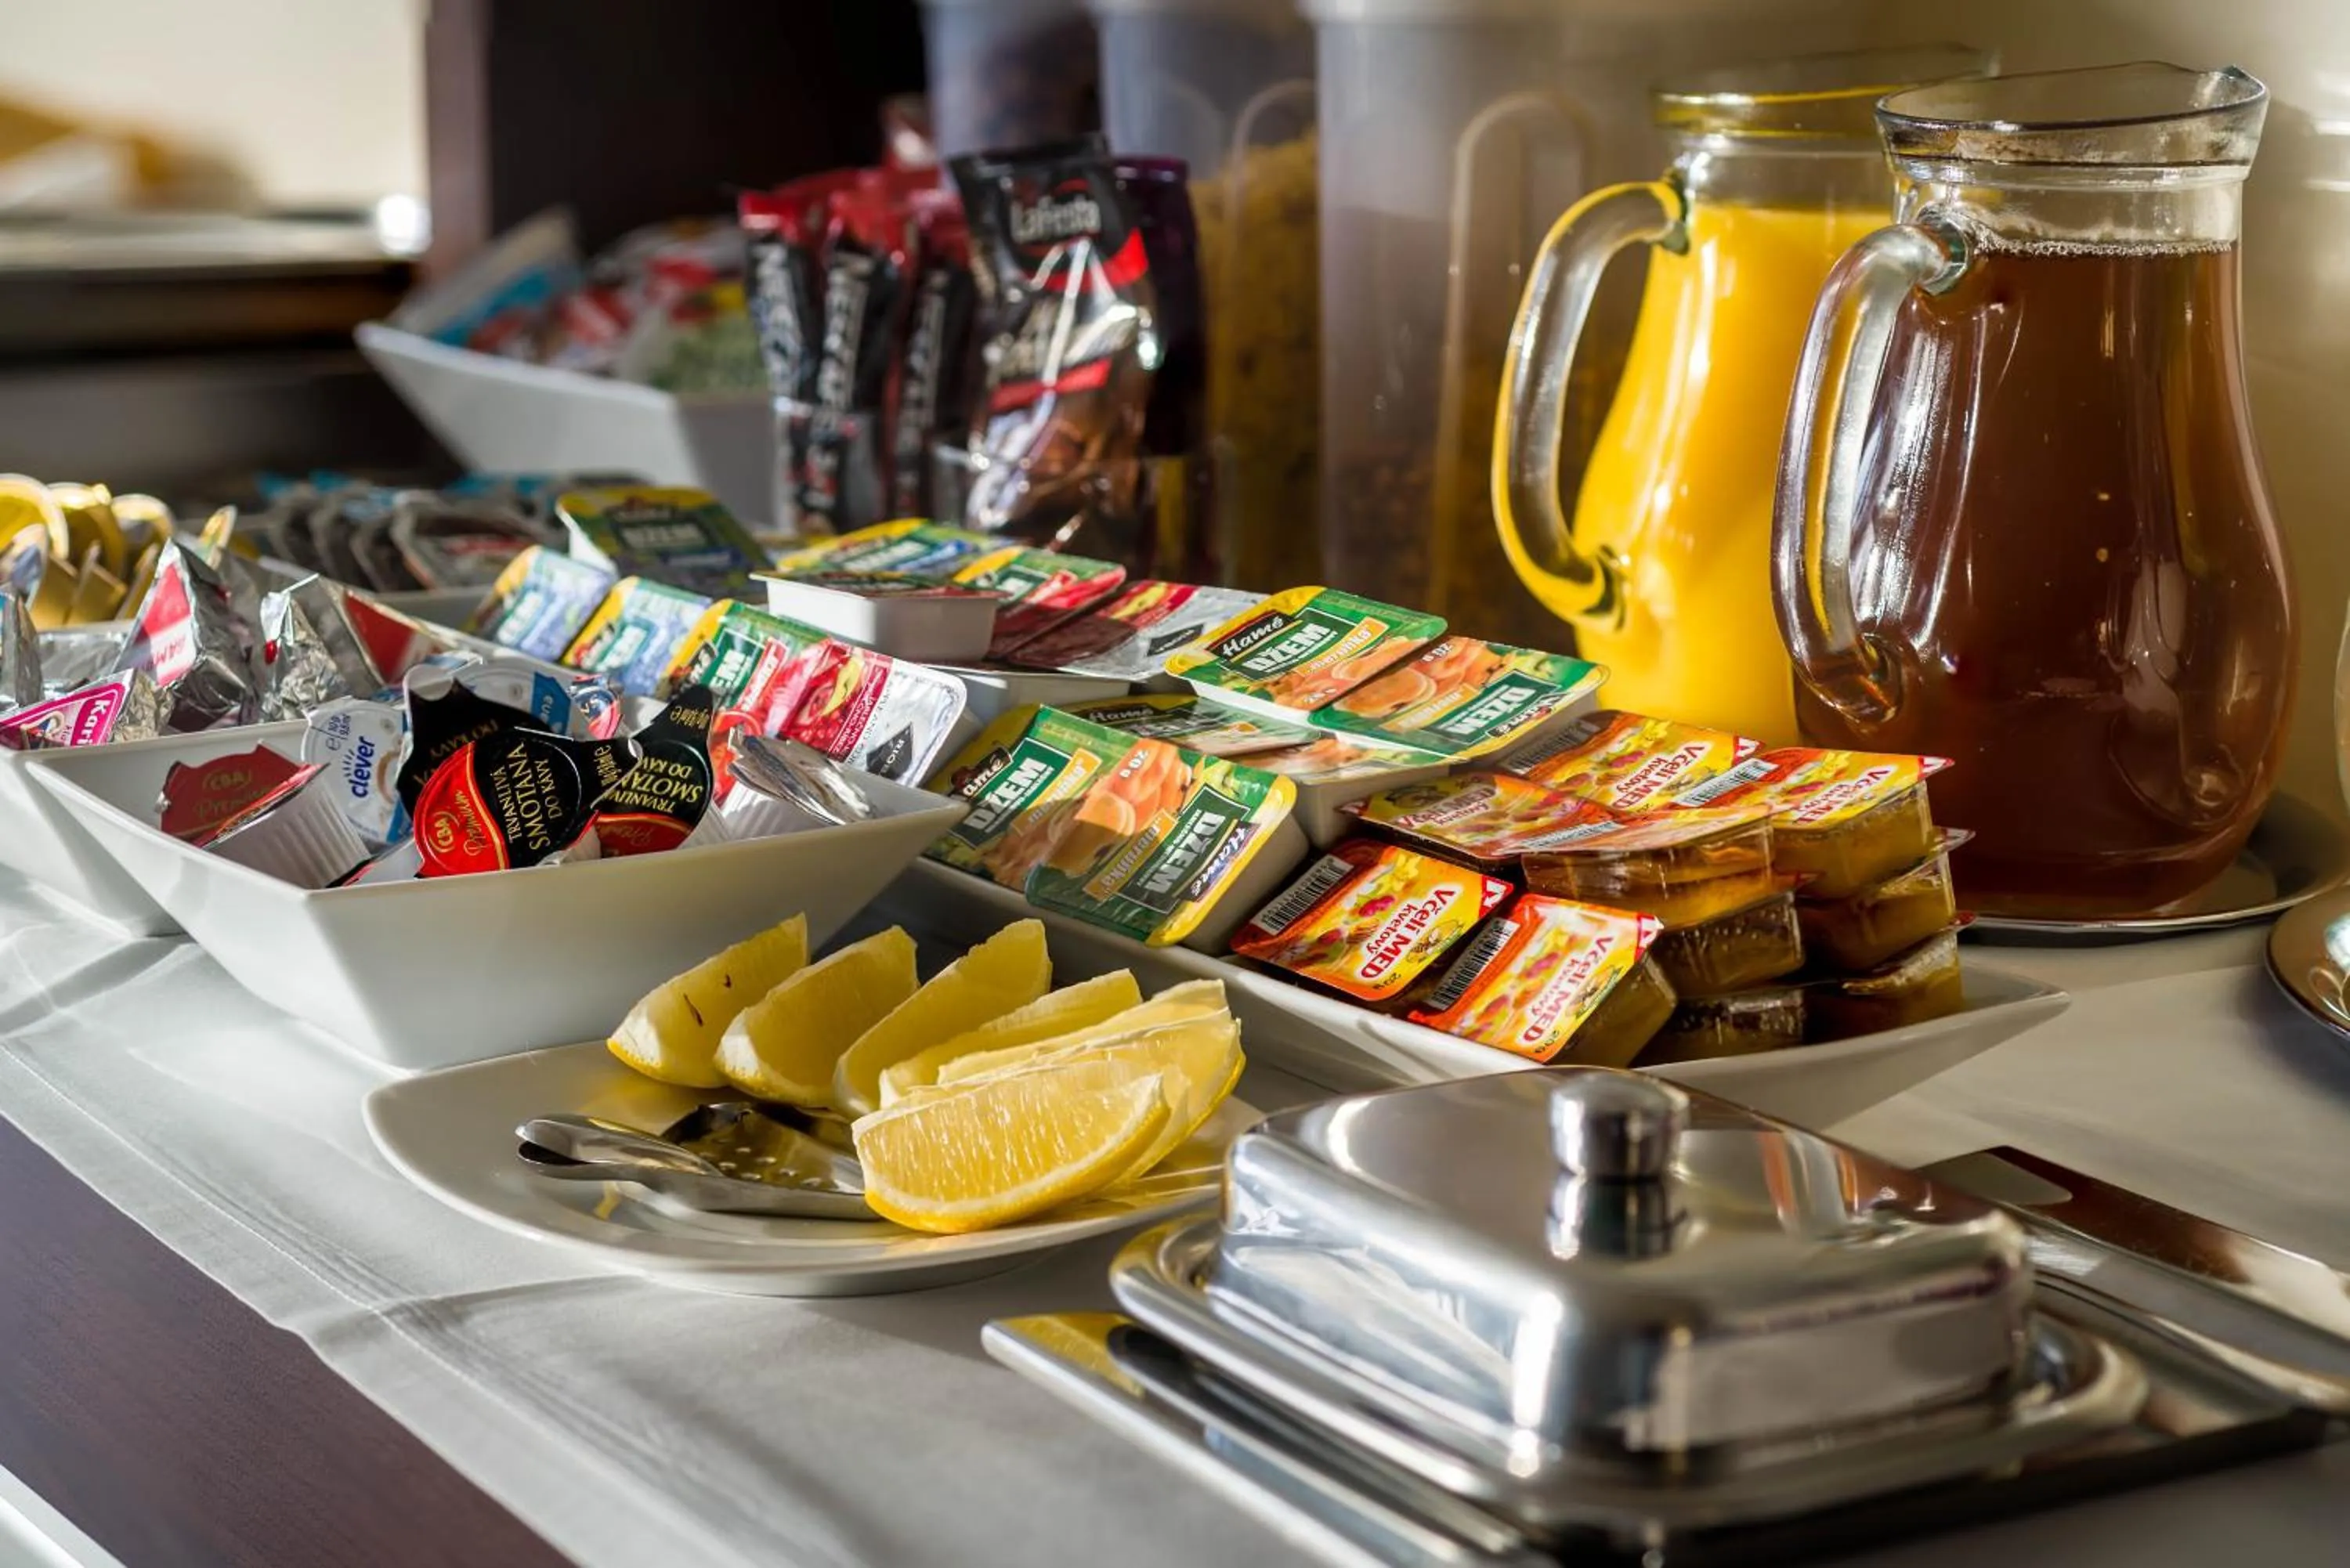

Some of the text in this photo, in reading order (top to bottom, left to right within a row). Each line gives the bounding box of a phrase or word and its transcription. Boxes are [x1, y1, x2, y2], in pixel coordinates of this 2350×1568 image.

[1222, 616, 1285, 659] Hamé
[1240, 620, 1331, 673] DŽEM
[83, 699, 110, 746] Kari
[1445, 687, 1537, 735] DŽEM
[350, 735, 376, 798] clever
[624, 766, 703, 804] SMOTA
[668, 764, 693, 779] DO
[1612, 746, 1705, 808] Včelí MED
[1617, 757, 1668, 793] kvetový
[490, 765, 523, 844] TRVANLIVÁ
[505, 742, 551, 851] SMOTANA
[548, 800, 562, 820] DO
[964, 757, 1049, 831] DŽEM
[436, 816, 455, 847] CBA
[1144, 811, 1226, 894] DŽEM
[1191, 827, 1248, 896] Hamé
[1360, 887, 1456, 979] Včelí MED
[1365, 902, 1419, 956] kvetový
[1523, 986, 1573, 1042] MED
